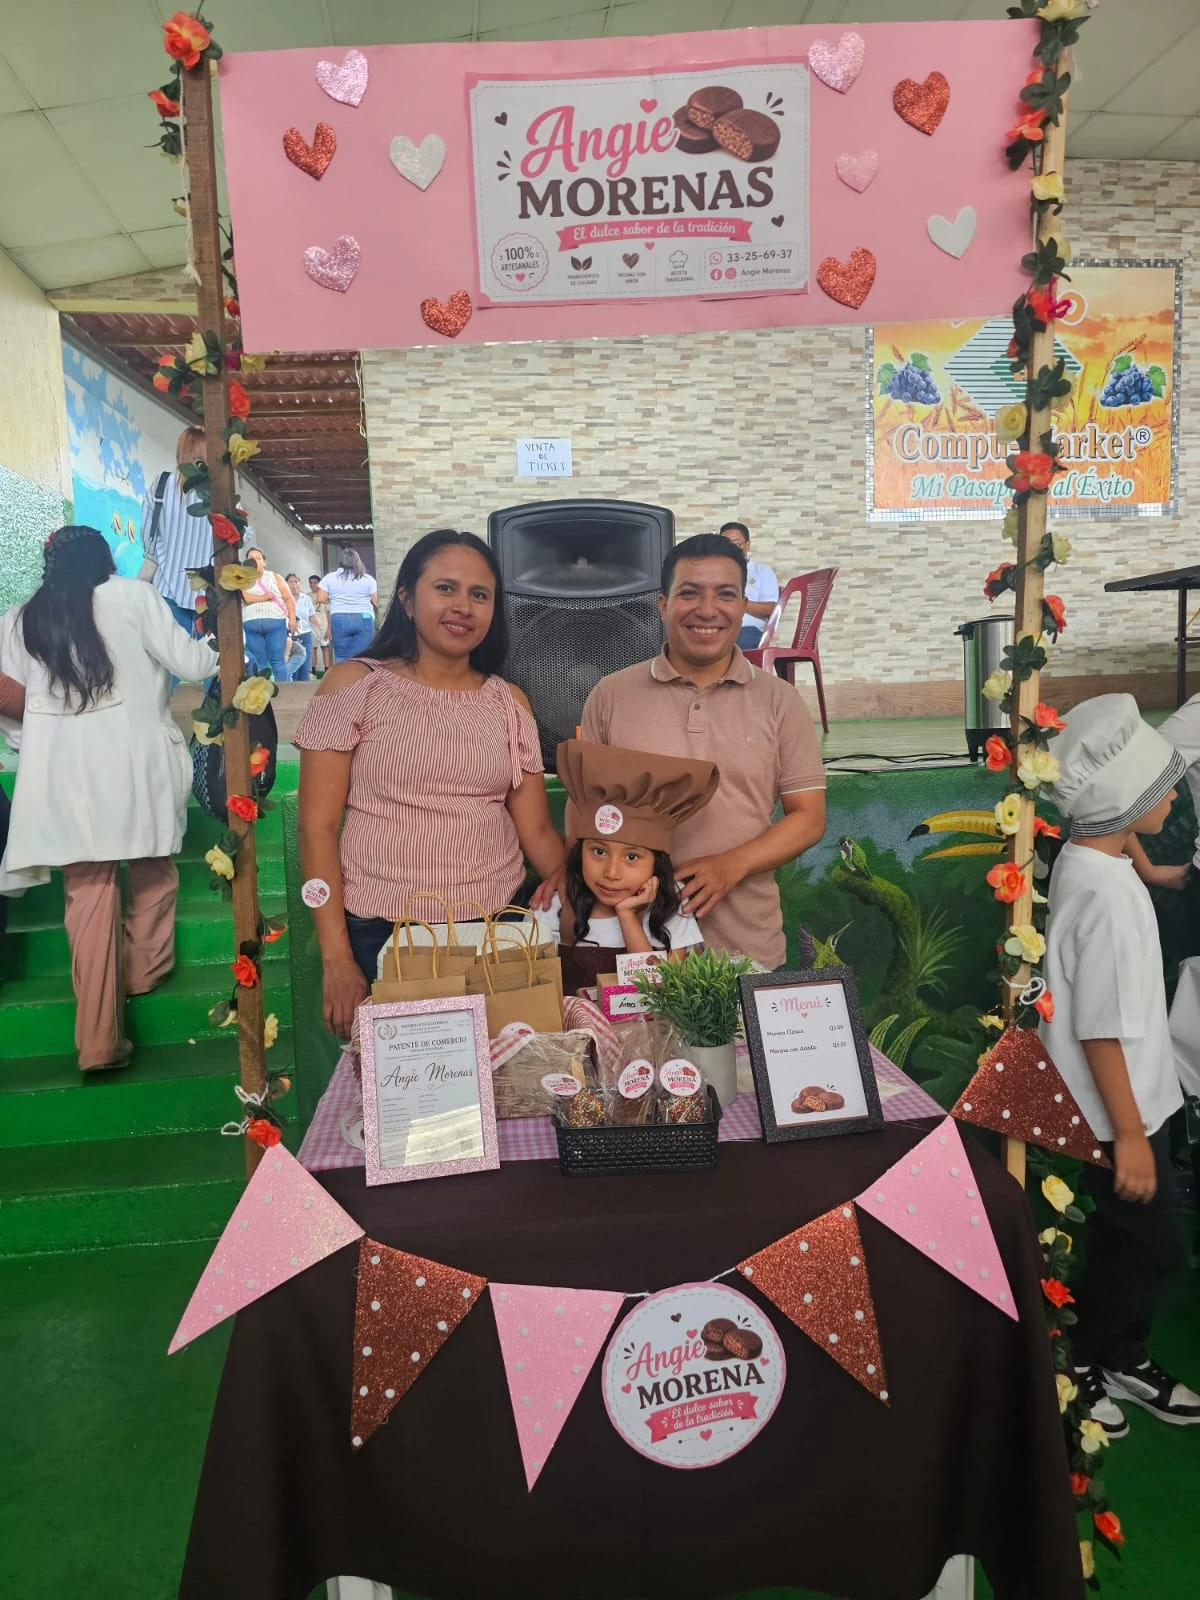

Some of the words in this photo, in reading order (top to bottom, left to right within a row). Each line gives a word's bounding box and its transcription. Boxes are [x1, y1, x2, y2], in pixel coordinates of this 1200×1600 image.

[520, 100, 680, 178] Angie
[517, 166, 774, 219] MORENAS
[573, 226, 588, 241] El
[590, 223, 620, 239] dulce
[622, 222, 654, 236] sabor
[656, 221, 671, 234] de
[673, 220, 685, 233] la
[687, 219, 736, 234] tradición
[505, 246, 535, 261] 100%
[727, 249, 793, 263] 33-25-69-37
[501, 262, 540, 272] ARTESANALES
[525, 443, 555, 452] VENTA
[912, 475, 945, 499] Mi
[948, 475, 1016, 505] Pasap
[1052, 472, 1077, 496] al
[1077, 467, 1133, 501] Éxito
[780, 997, 824, 1013] Menú
[388, 1041, 420, 1051] PATENTE
[432, 1036, 467, 1046] COMERCIO
[380, 1064, 421, 1090] Angie
[424, 1062, 474, 1083] Morenas
[626, 1338, 706, 1381] Angie
[637, 1362, 764, 1410] MORENA
[671, 1407, 682, 1420] El
[683, 1402, 707, 1416] dulce
[708, 1397, 733, 1409] sabor
[673, 1419, 684, 1430] de
[685, 1415, 694, 1427] la
[696, 1408, 734, 1424] tradición
